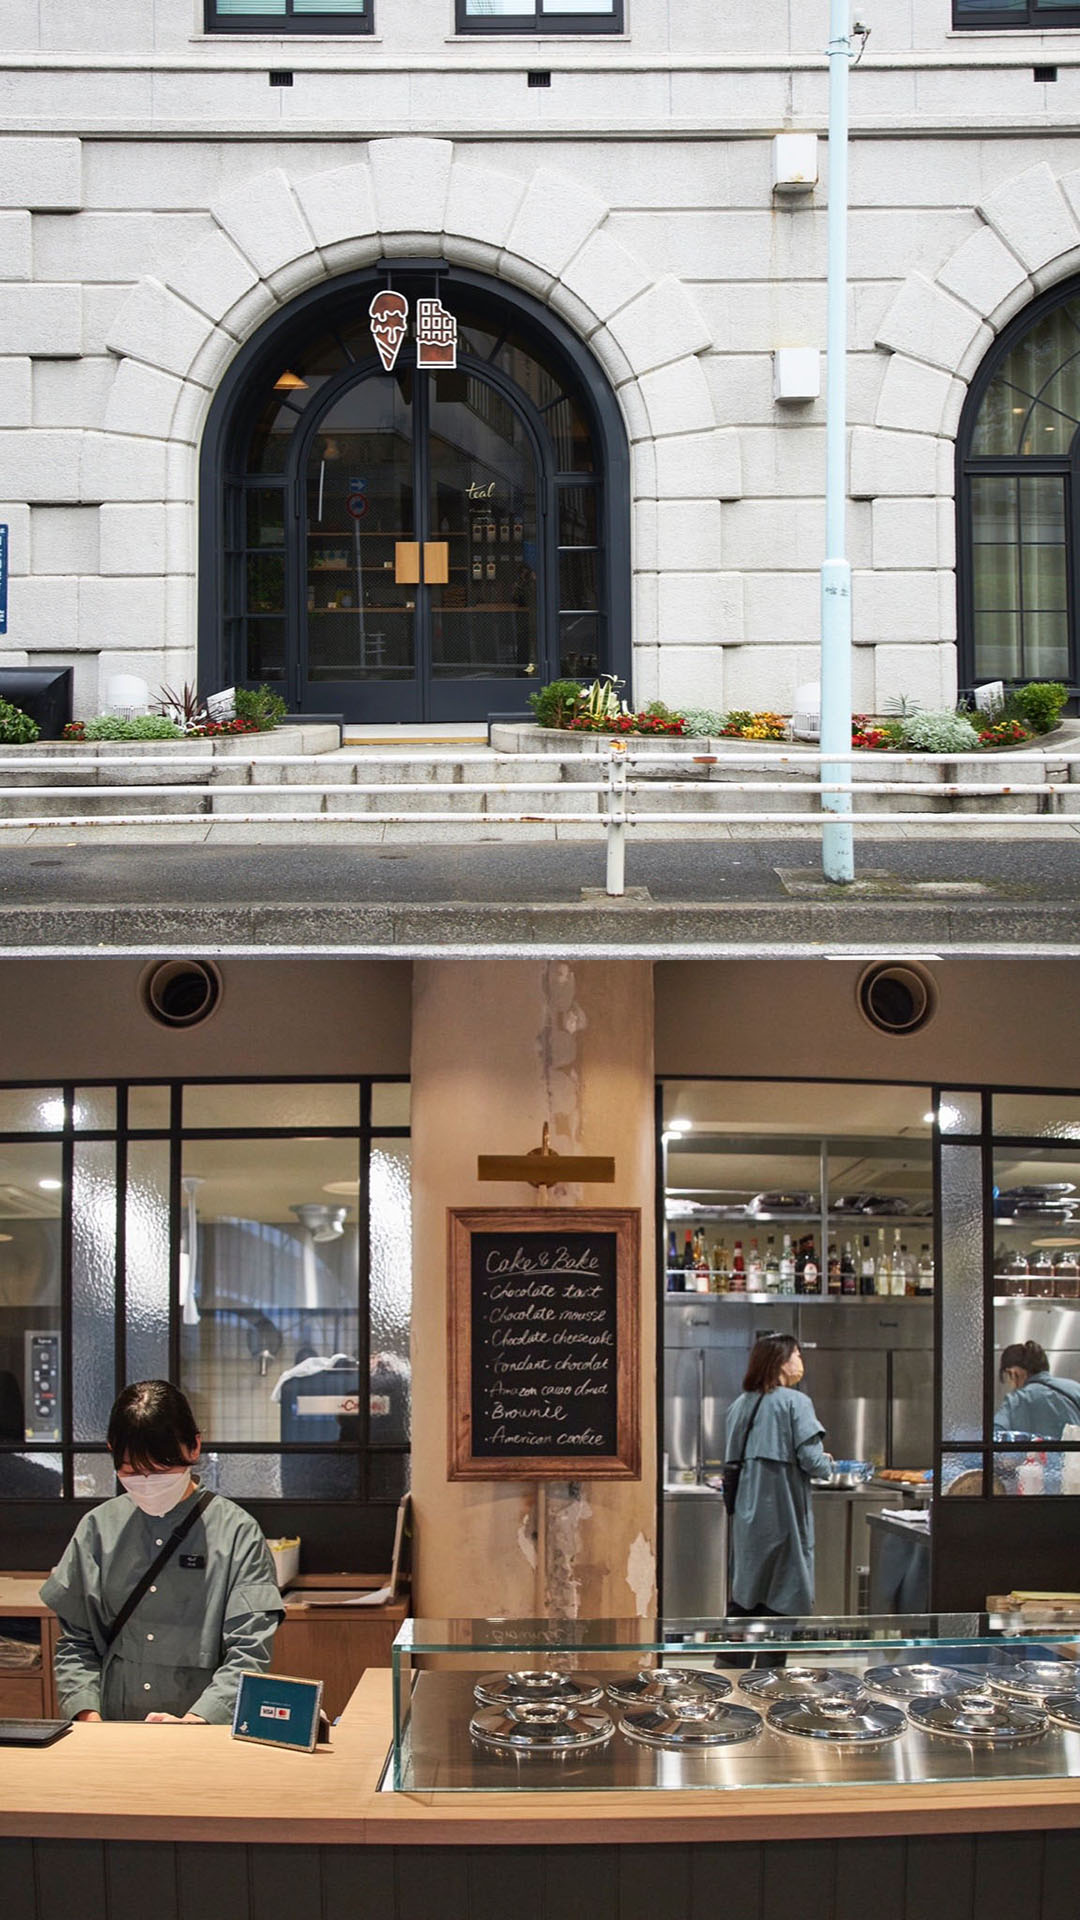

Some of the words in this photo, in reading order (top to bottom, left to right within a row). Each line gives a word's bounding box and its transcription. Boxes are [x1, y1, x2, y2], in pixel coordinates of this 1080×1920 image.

[465, 482, 495, 499] teal
[485, 1247, 537, 1273] Cake
[539, 1251, 549, 1266] &
[551, 1246, 600, 1271] Bake
[490, 1281, 556, 1300] Chocolate
[561, 1284, 604, 1298] tart
[489, 1304, 557, 1323] Chocolate
[559, 1309, 607, 1321] mousse
[491, 1328, 551, 1347] Chocolate
[554, 1353, 609, 1371] chocolat
[491, 1400, 568, 1421] Brownie
[489, 1425, 553, 1445] American
[556, 1427, 606, 1446] cookie
